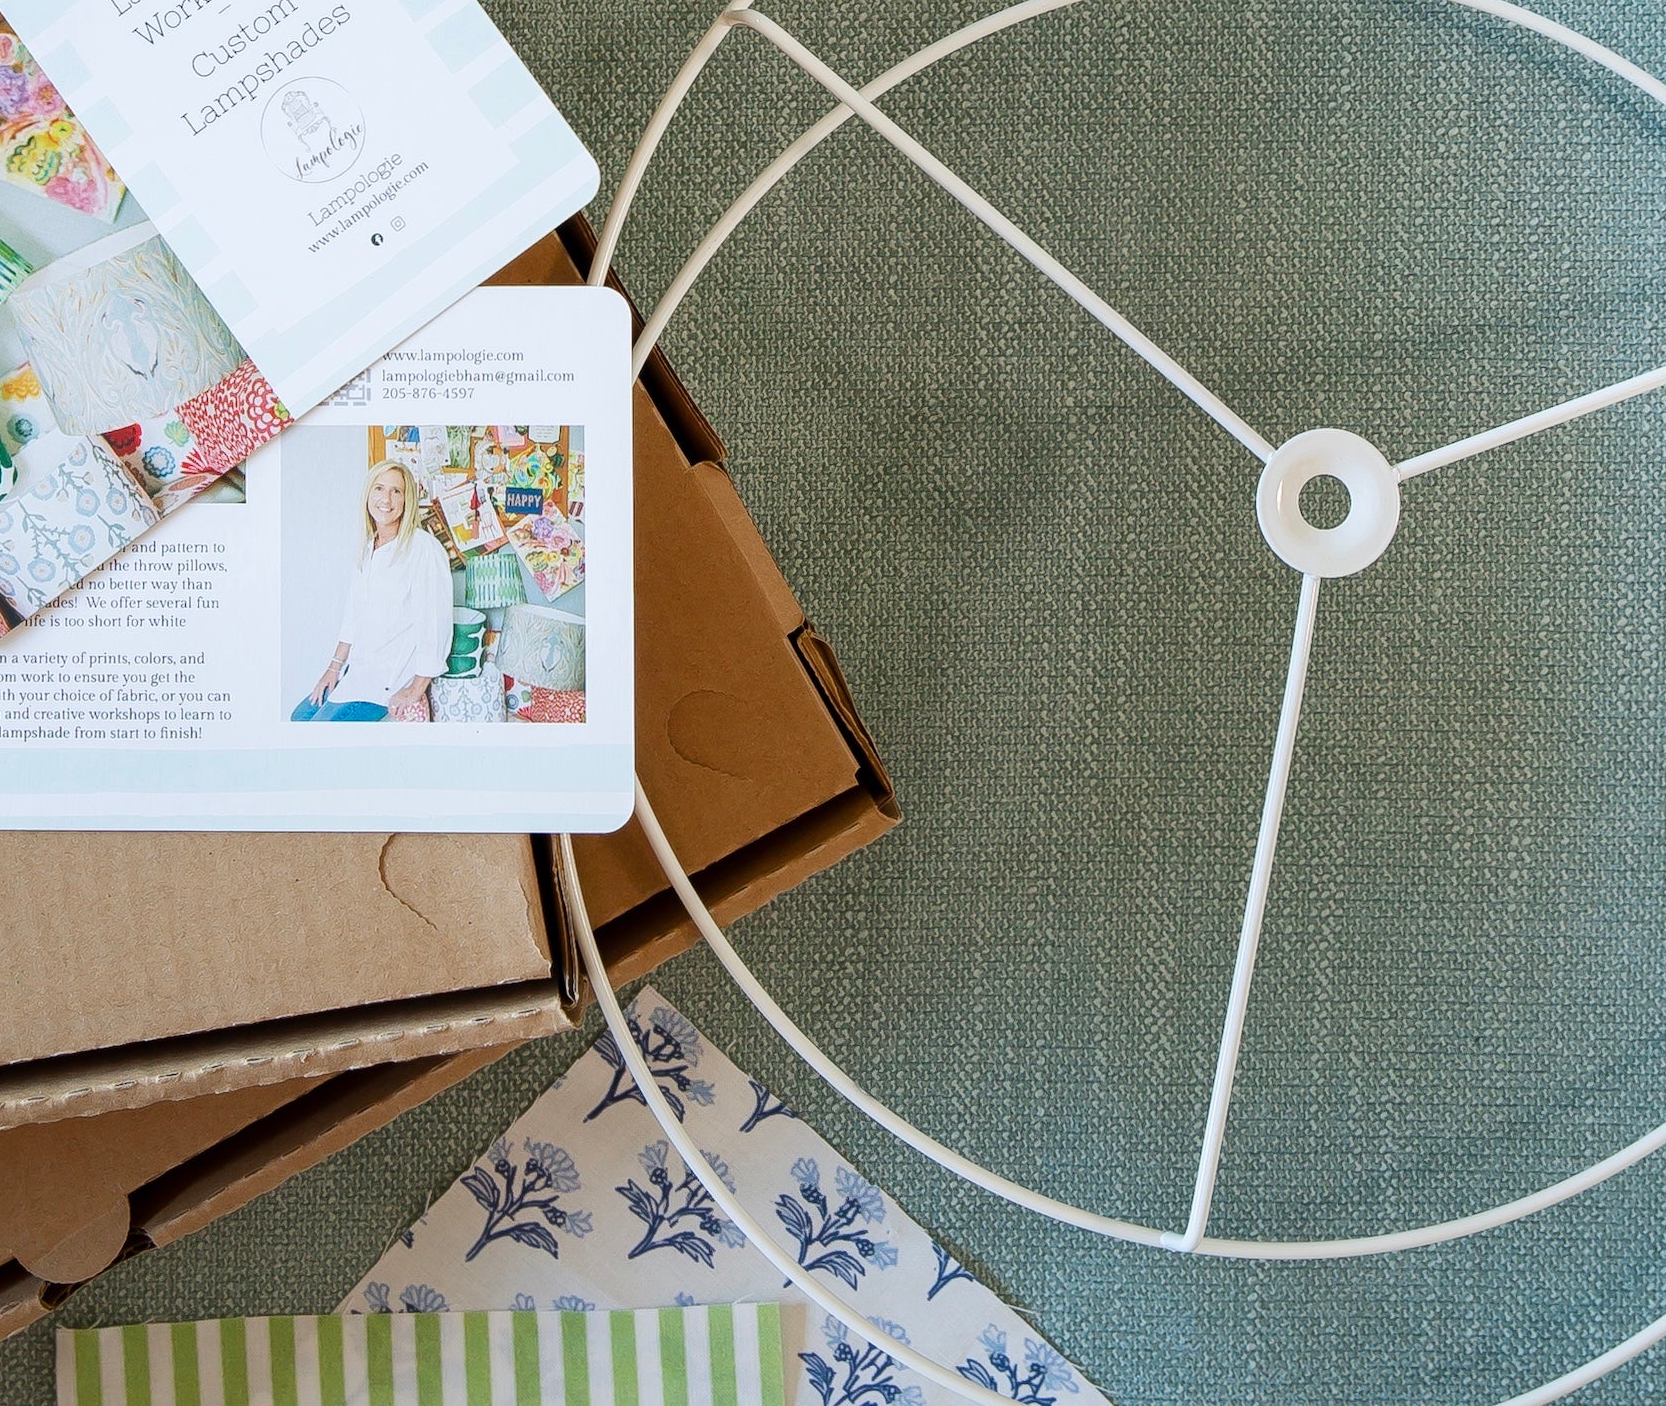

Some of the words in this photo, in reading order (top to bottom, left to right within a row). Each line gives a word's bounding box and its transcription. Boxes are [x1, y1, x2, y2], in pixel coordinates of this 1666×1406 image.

[180, 3, 351, 136] Lampshades
[307, 154, 403, 227] Lampologie
[308, 161, 429, 253] www.lampologie.com
[382, 349, 524, 364] www.lampologie.com
[382, 369, 574, 386] lampologiebham@gmail.com
[382, 388, 475, 400] 205-876-4597
[507, 492, 542, 508] HAPPY
[131, 540, 156, 553] and
[161, 544, 208, 558] pattern
[213, 544, 226, 553] to
[109, 559, 130, 571] the
[134, 559, 173, 572] throw
[177, 559, 228, 577] pillows,
[89, 581, 105, 590] no
[110, 577, 147, 590] better
[151, 582, 178, 595] way
[182, 578, 213, 590] than
[86, 596, 107, 608] We
[110, 596, 143, 608] offer
[146, 596, 191, 609] several
[196, 596, 220, 609] fun
[50, 615, 60, 627] is
[65, 618, 84, 627] too
[88, 615, 121, 627] short
[126, 615, 145, 628] for
[148, 615, 187, 628] white
[11, 655, 19, 664] a
[23, 652, 68, 669] variety
[71, 652, 87, 664] of
[89, 653, 131, 669] prints,
[134, 652, 176, 667] colors,
[180, 652, 205, 665] and
[21, 670, 54, 683] work
[58, 673, 71, 683] to
[74, 674, 119, 683] ensure
[123, 674, 147, 688] you
[150, 674, 169, 688] get
[174, 671, 195, 683] the
[19, 692, 50, 706] your
[53, 689, 95, 701] choice
[99, 689, 114, 701] of
[117, 689, 158, 704] fabric,
[161, 693, 176, 702] or
[179, 693, 203, 706] you
[207, 693, 231, 702] can
[5, 707, 30, 719] and
[34, 708, 85, 720] creative
[89, 707, 160, 725] workshops
[164, 711, 177, 720] to
[181, 708, 215, 720] learn
[219, 711, 232, 720] to
[75, 726, 106, 739] from
[109, 729, 140, 739] start
[143, 729, 157, 739] to
[161, 727, 203, 739] finish!
